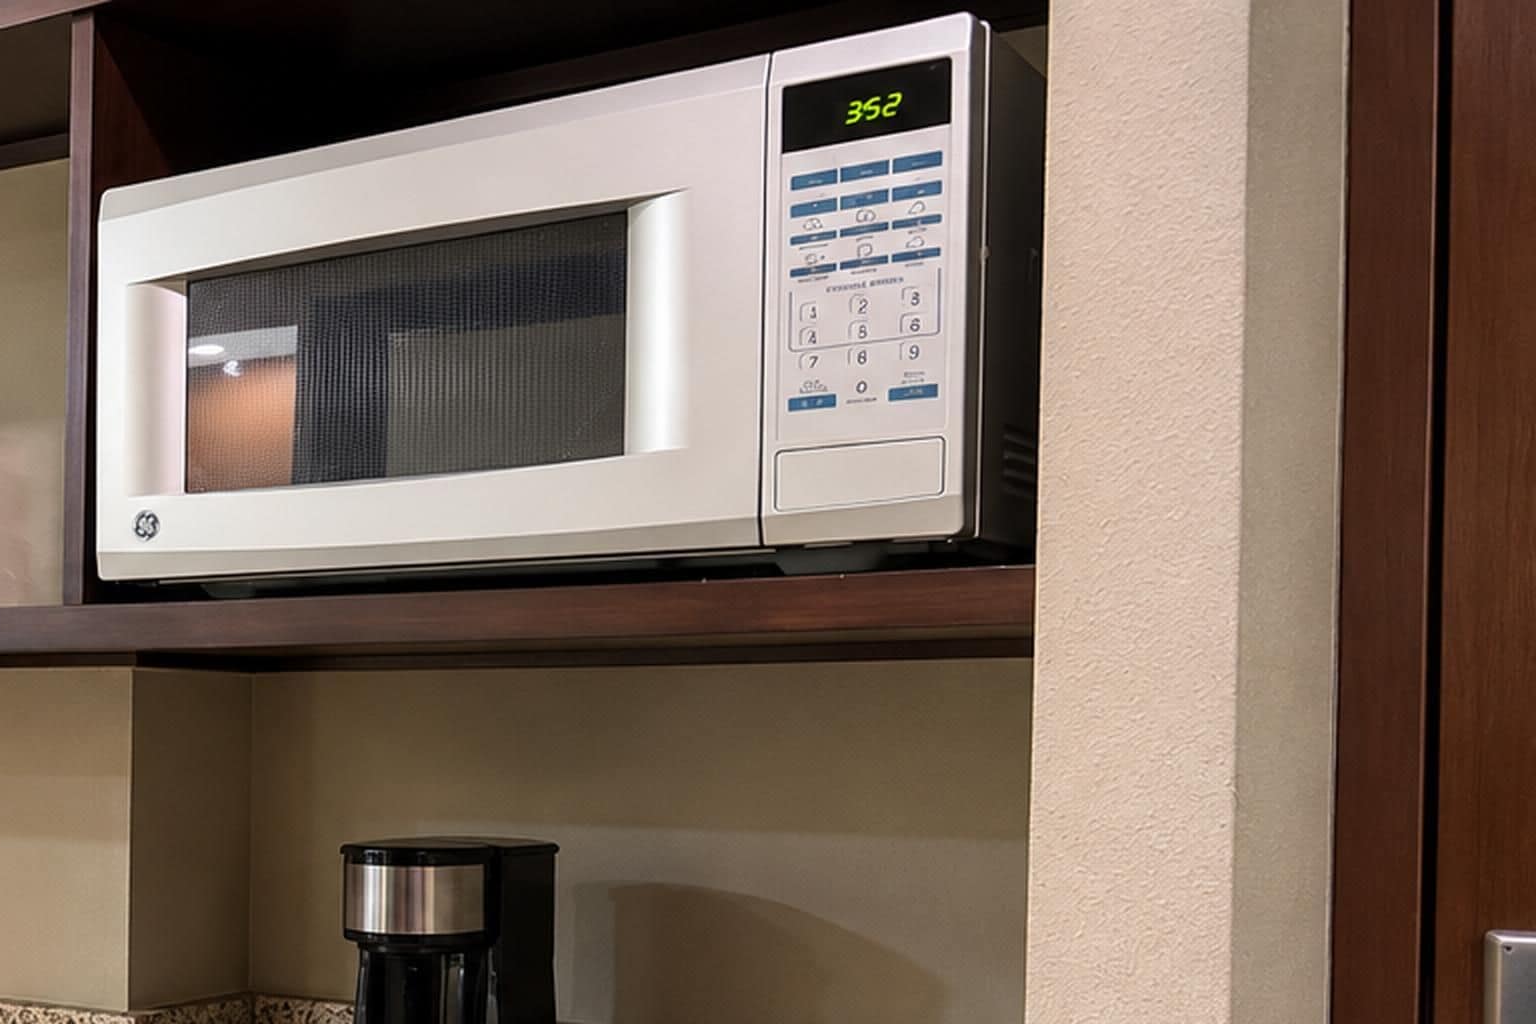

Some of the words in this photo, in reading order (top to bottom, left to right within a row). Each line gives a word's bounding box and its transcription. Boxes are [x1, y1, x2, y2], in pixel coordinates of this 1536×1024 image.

[910, 292, 920, 306] 3
[857, 298, 869, 315] 2
[909, 318, 921, 332] 6
[857, 350, 867, 365] 8
[908, 344, 920, 360] 9
[809, 355, 819, 369] 7
[855, 380, 868, 394] 0
